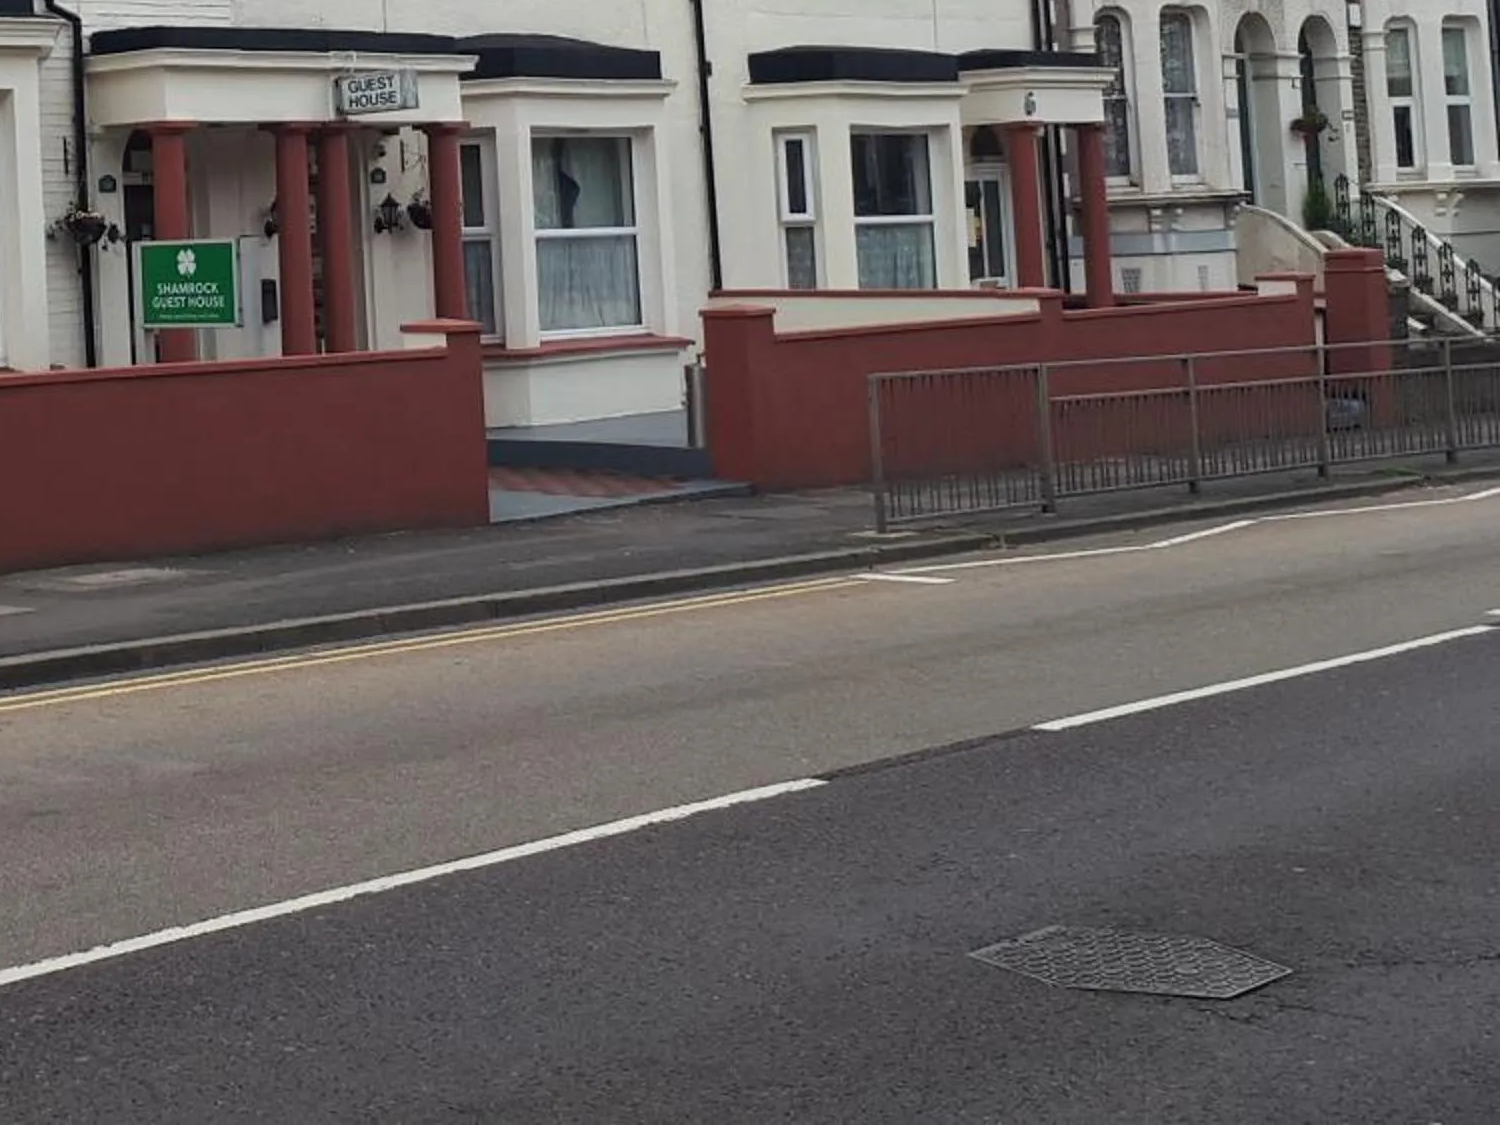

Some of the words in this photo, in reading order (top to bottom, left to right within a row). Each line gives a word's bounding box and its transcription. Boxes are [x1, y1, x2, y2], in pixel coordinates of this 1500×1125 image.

[348, 75, 395, 93] GUEST
[349, 91, 396, 108] HOUSE
[157, 282, 219, 295] SHAMROCK
[152, 296, 187, 308] GUEST
[188, 296, 225, 308] HOUSE
